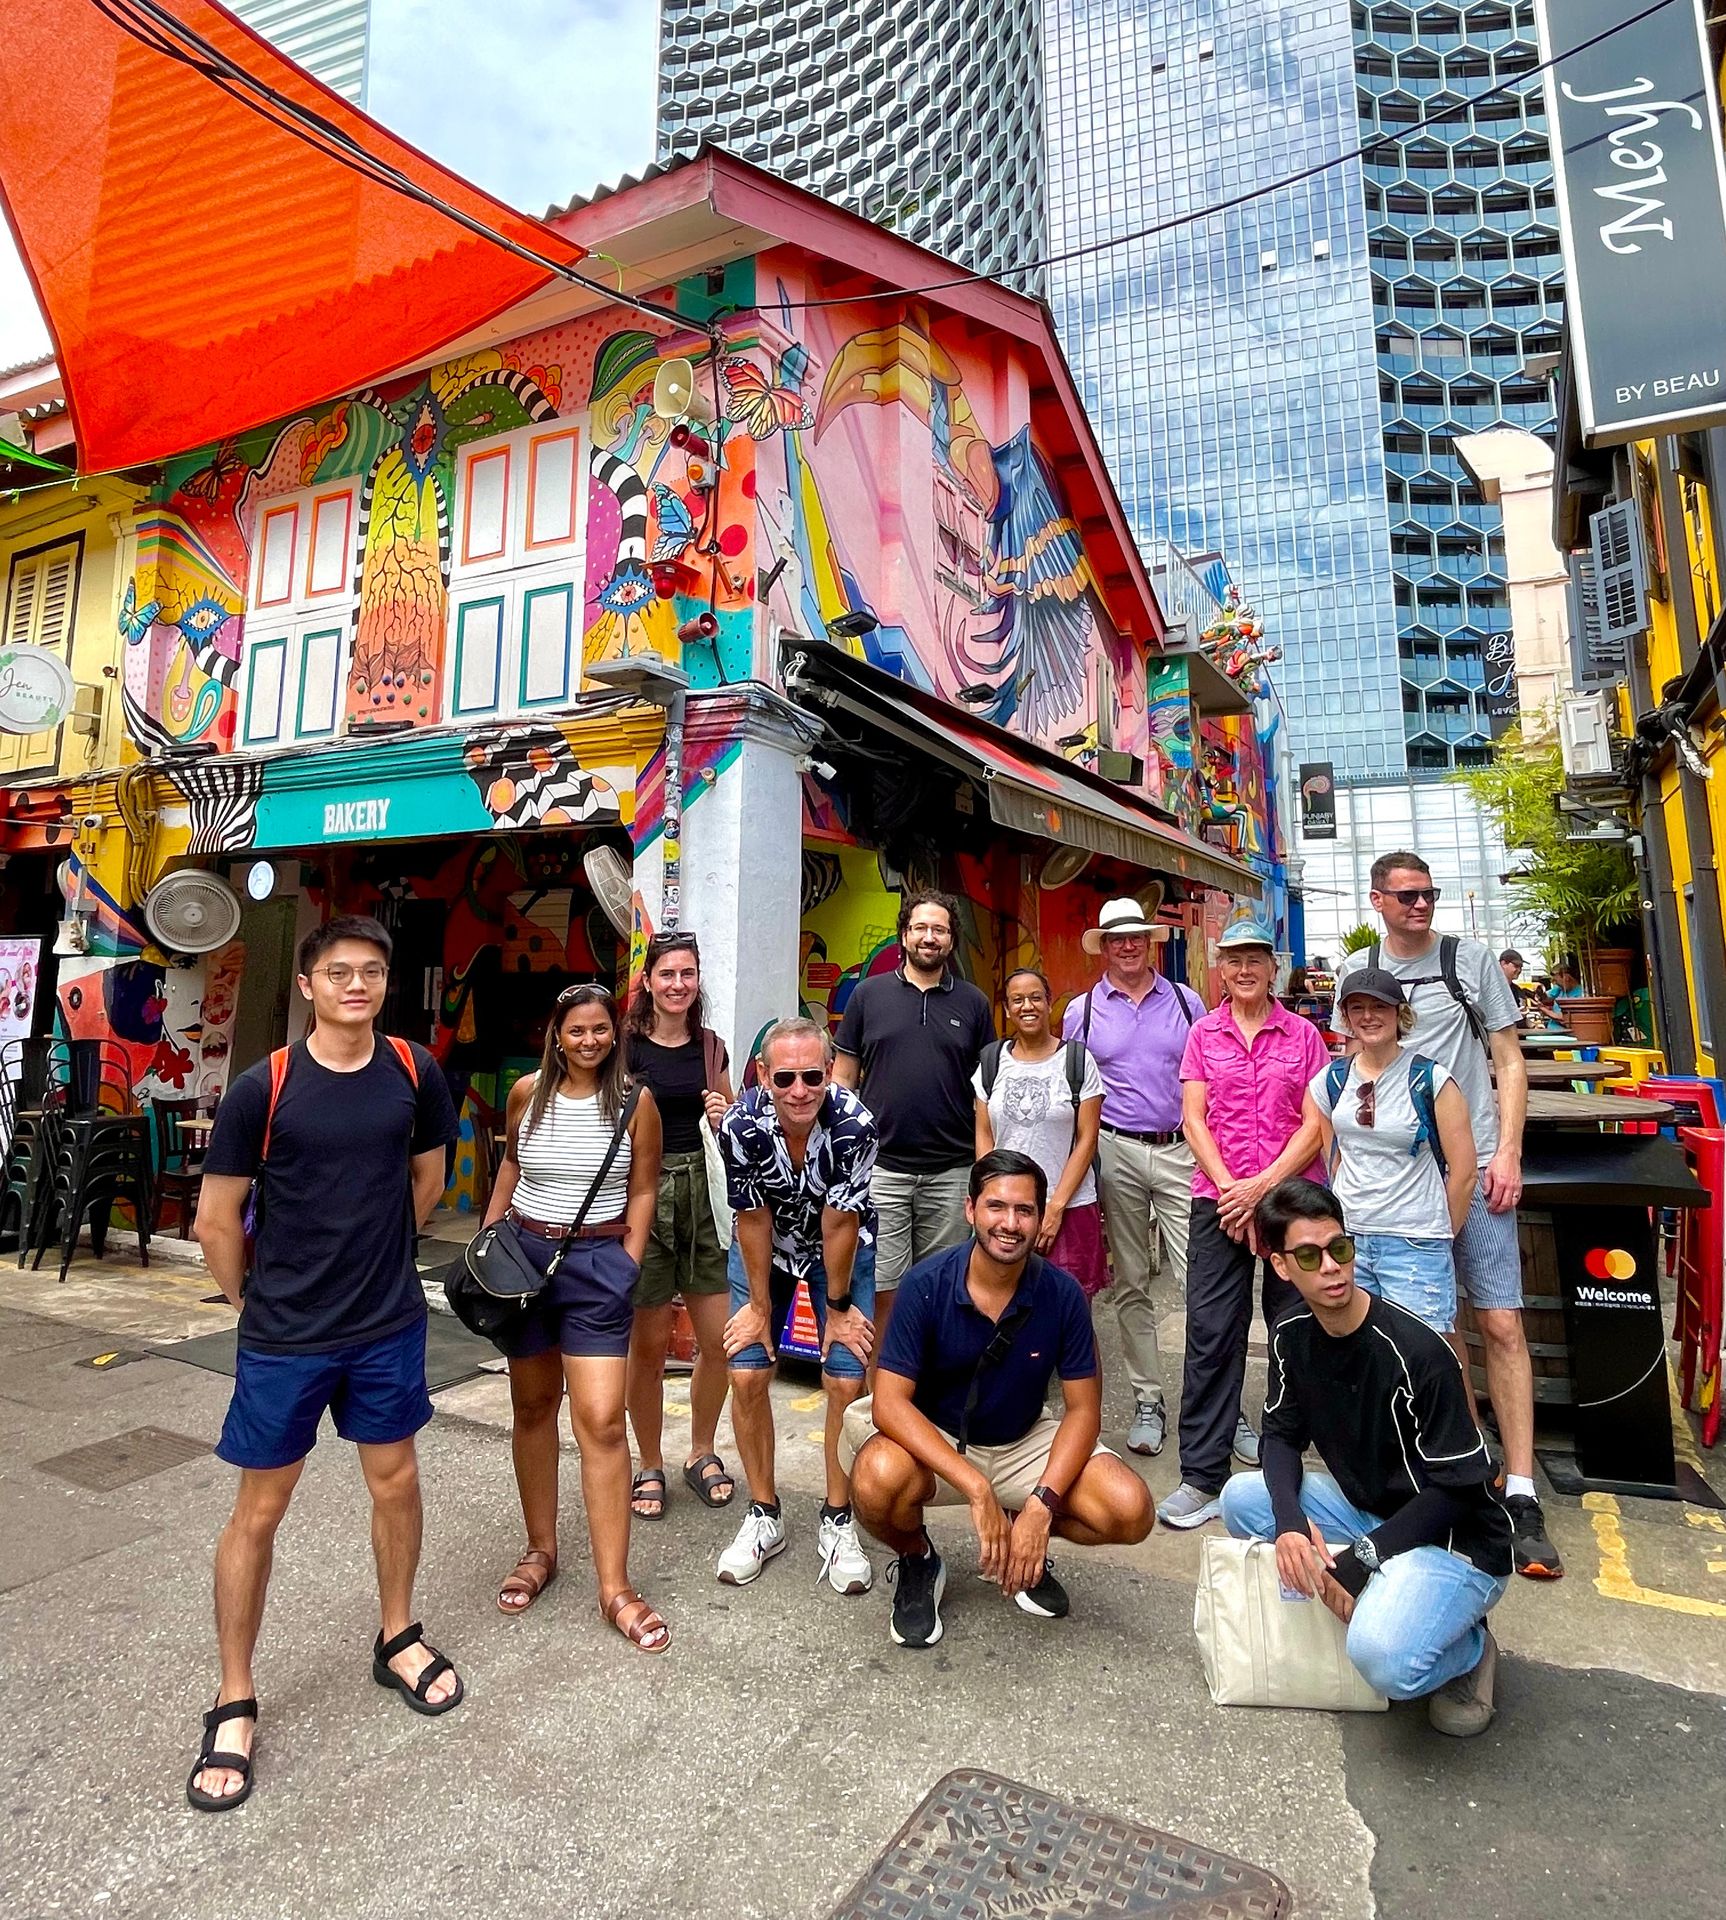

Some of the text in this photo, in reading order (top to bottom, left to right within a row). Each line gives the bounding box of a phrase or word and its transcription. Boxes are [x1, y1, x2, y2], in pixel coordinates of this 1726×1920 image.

[1615, 369, 1720, 404] BY BEAU
[0, 667, 32, 698] Jen
[16, 692, 54, 703] BEAUTY
[323, 798, 391, 836] BAKERY
[1576, 1286, 1652, 1304] Welcome
[946, 1803, 1033, 1842] SEW
[984, 1884, 1079, 1918] SUNWAY
